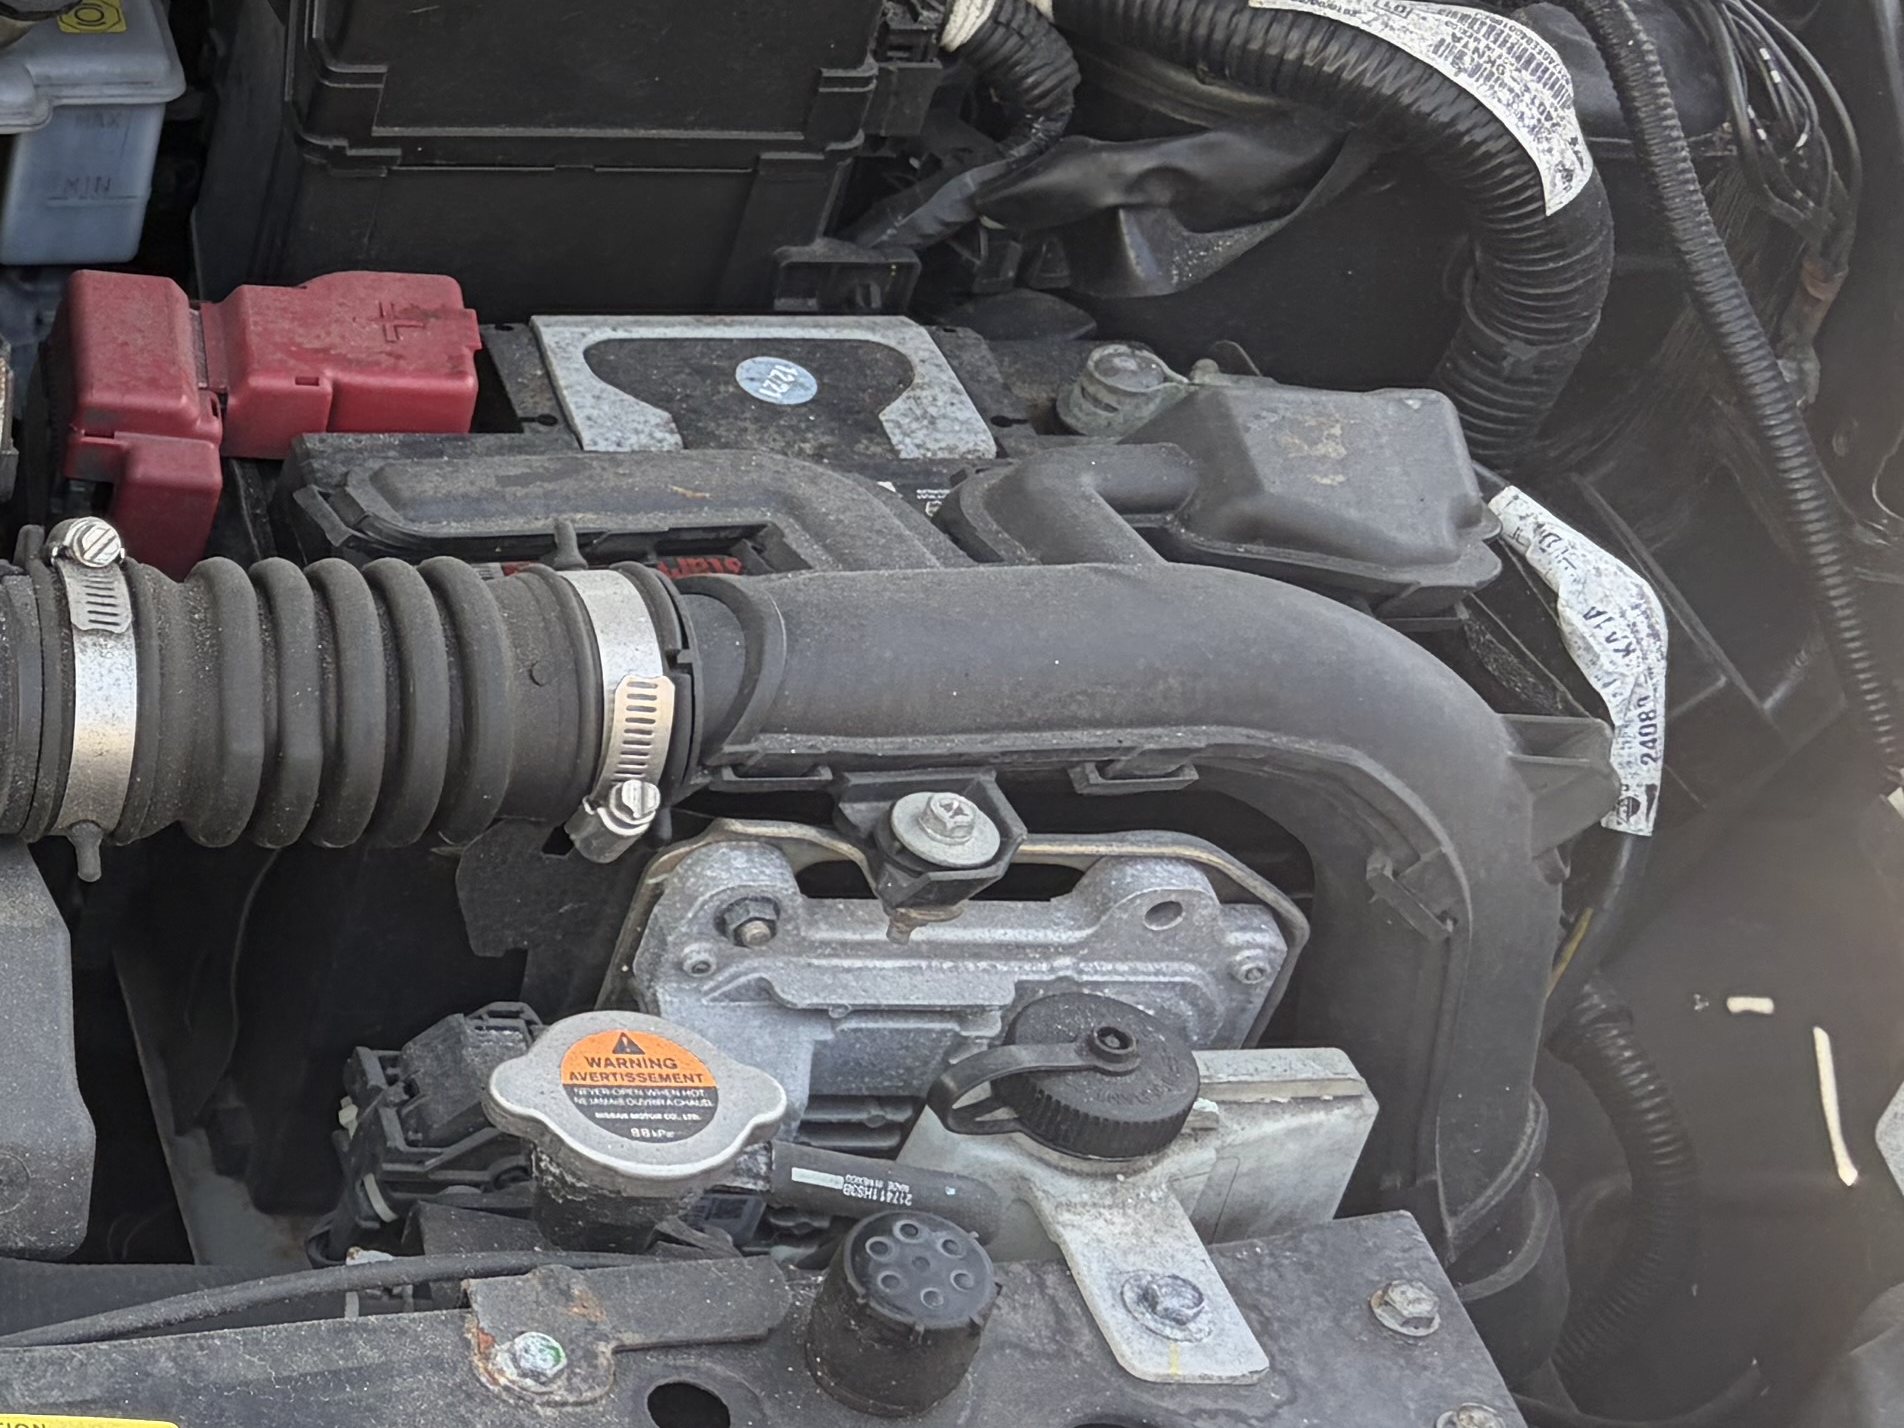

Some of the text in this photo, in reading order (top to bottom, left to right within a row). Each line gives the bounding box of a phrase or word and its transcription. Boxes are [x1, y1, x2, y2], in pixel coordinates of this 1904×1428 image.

[63, 176, 112, 194] MIN
[584, 1056, 677, 1070] WARNING
[569, 1071, 704, 1084] AVERTISSEMENT
[573, 1088, 610, 1096] NEVER
[612, 1088, 642, 1096] OPEN
[644, 1089, 681, 1097] WHEN
[630, 1112, 662, 1120] MOTOR
